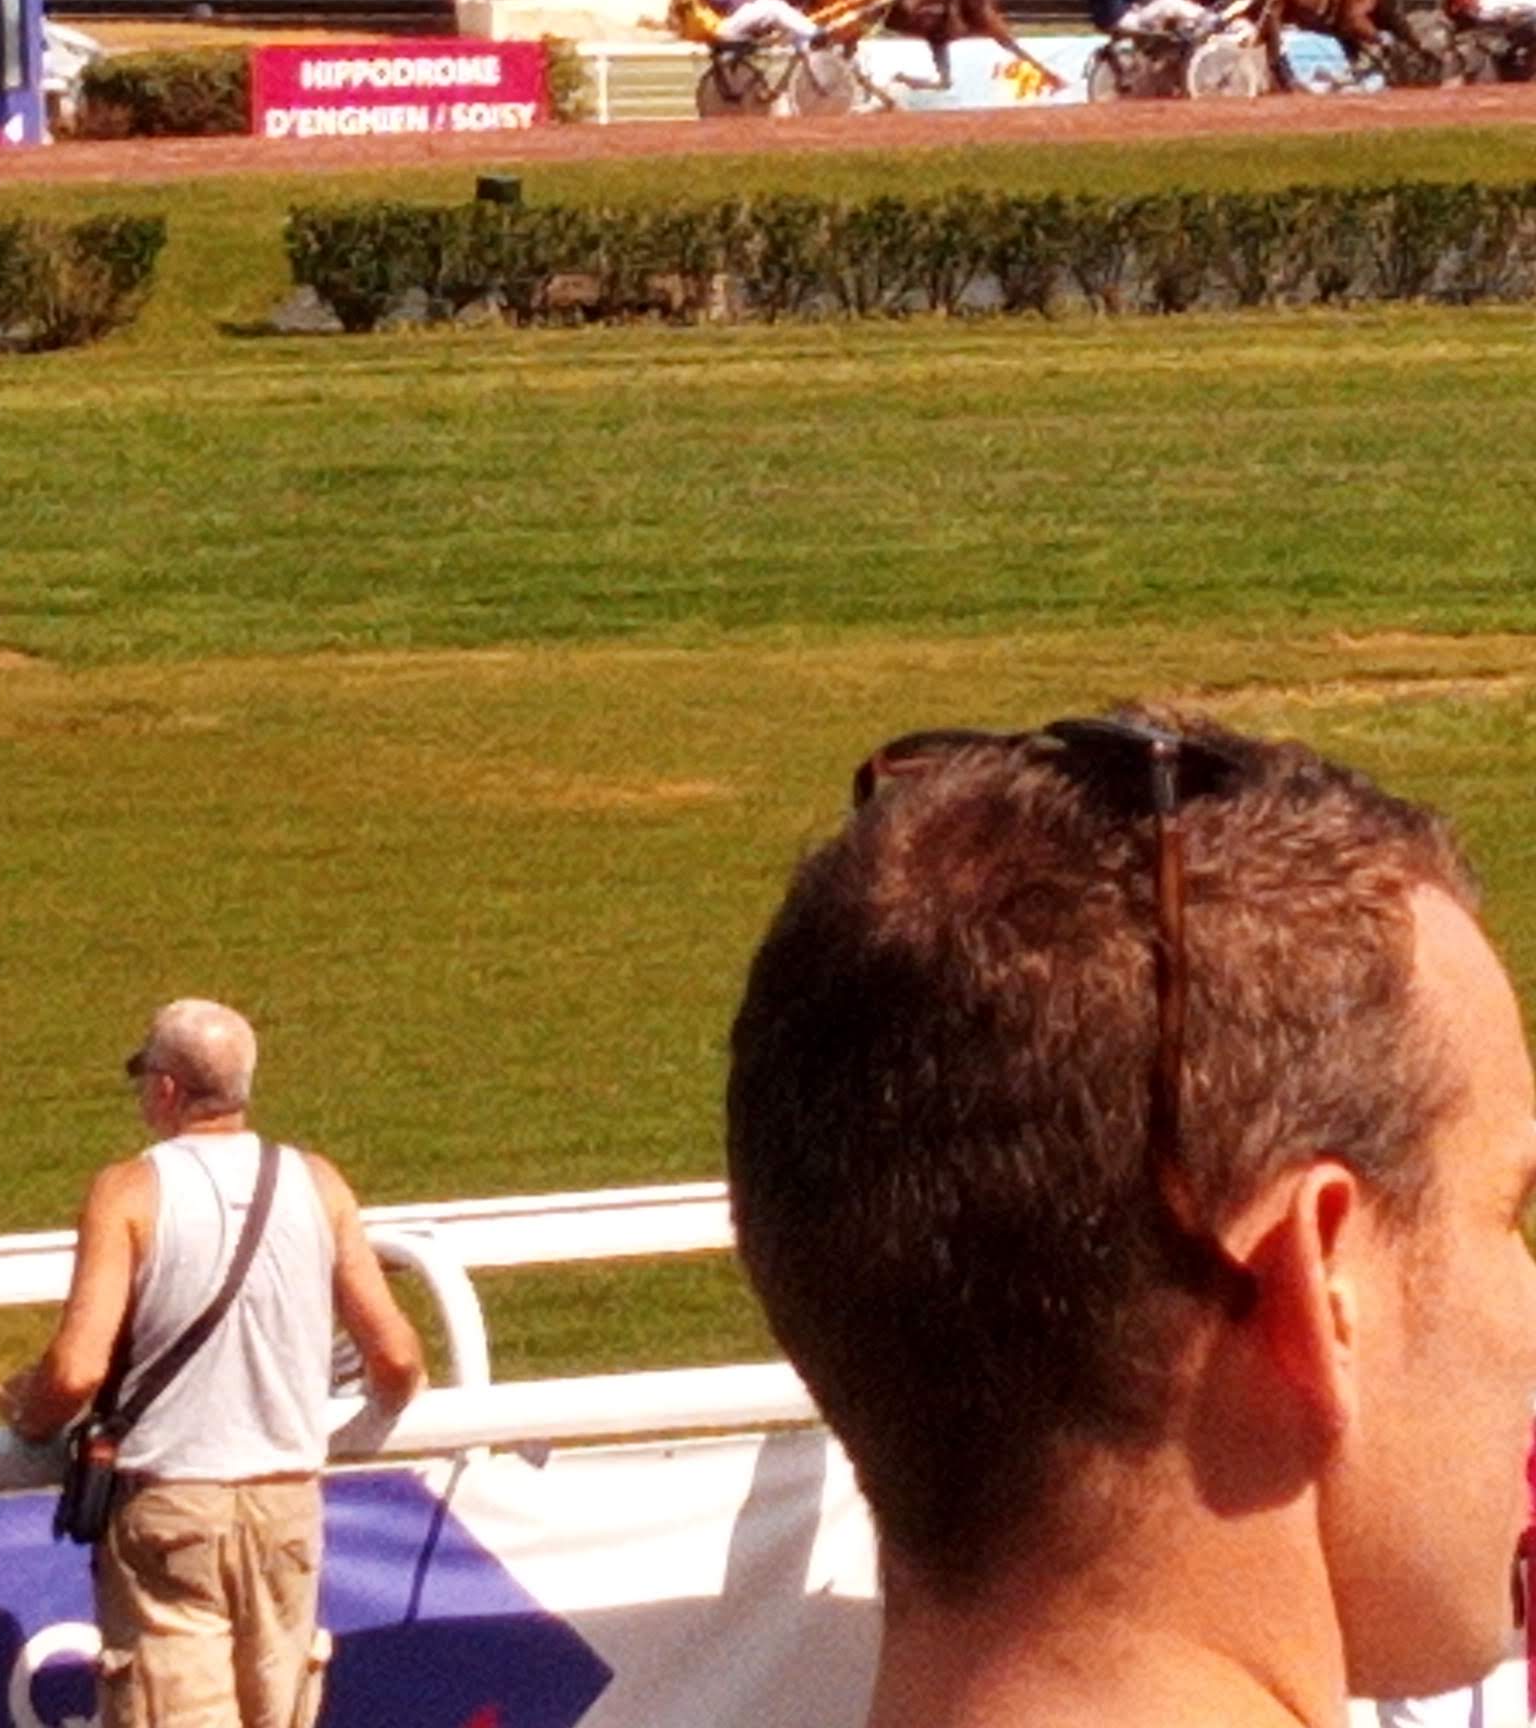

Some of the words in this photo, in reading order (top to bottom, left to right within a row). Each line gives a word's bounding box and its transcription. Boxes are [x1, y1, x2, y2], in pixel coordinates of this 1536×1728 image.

[300, 55, 501, 89] HIPPODROME
[265, 105, 429, 137] D'ENGHIEN
[450, 102, 537, 132] SOISY
